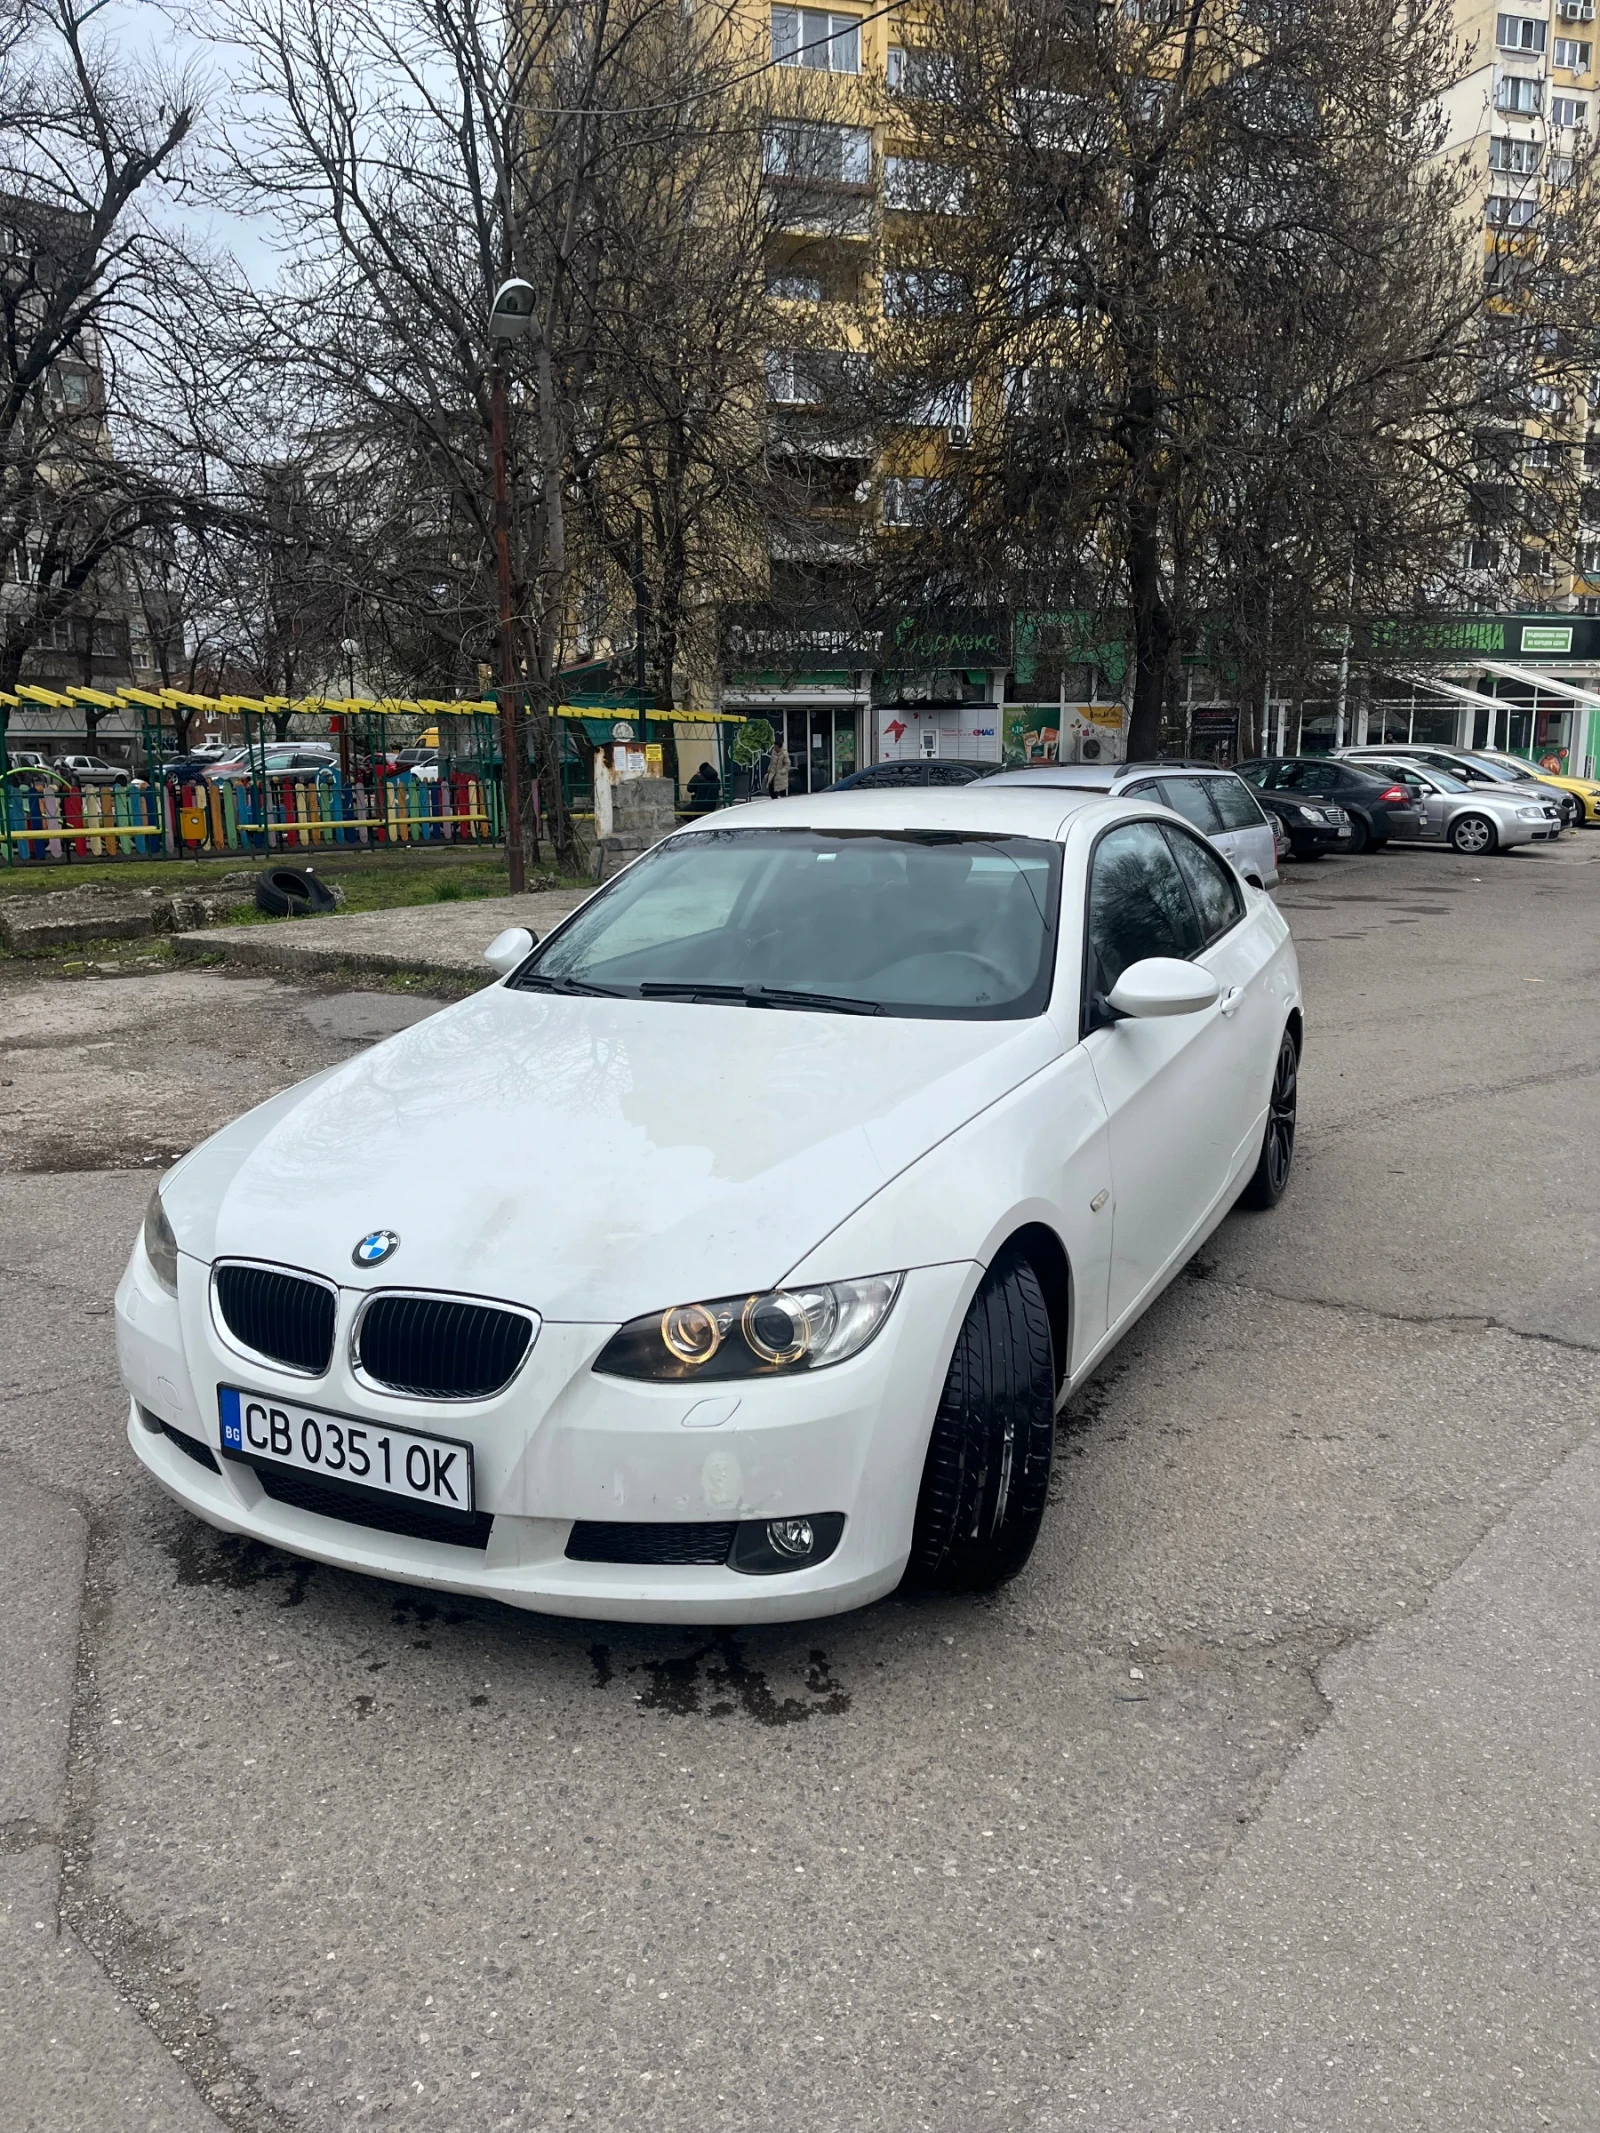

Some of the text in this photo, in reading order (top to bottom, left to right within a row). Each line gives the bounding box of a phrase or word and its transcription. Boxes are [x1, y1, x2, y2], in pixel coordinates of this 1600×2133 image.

[366, 1230, 398, 1244] BMW
[225, 1425, 240, 1442] BG
[245, 1402, 460, 1502] CB 0351 OK
